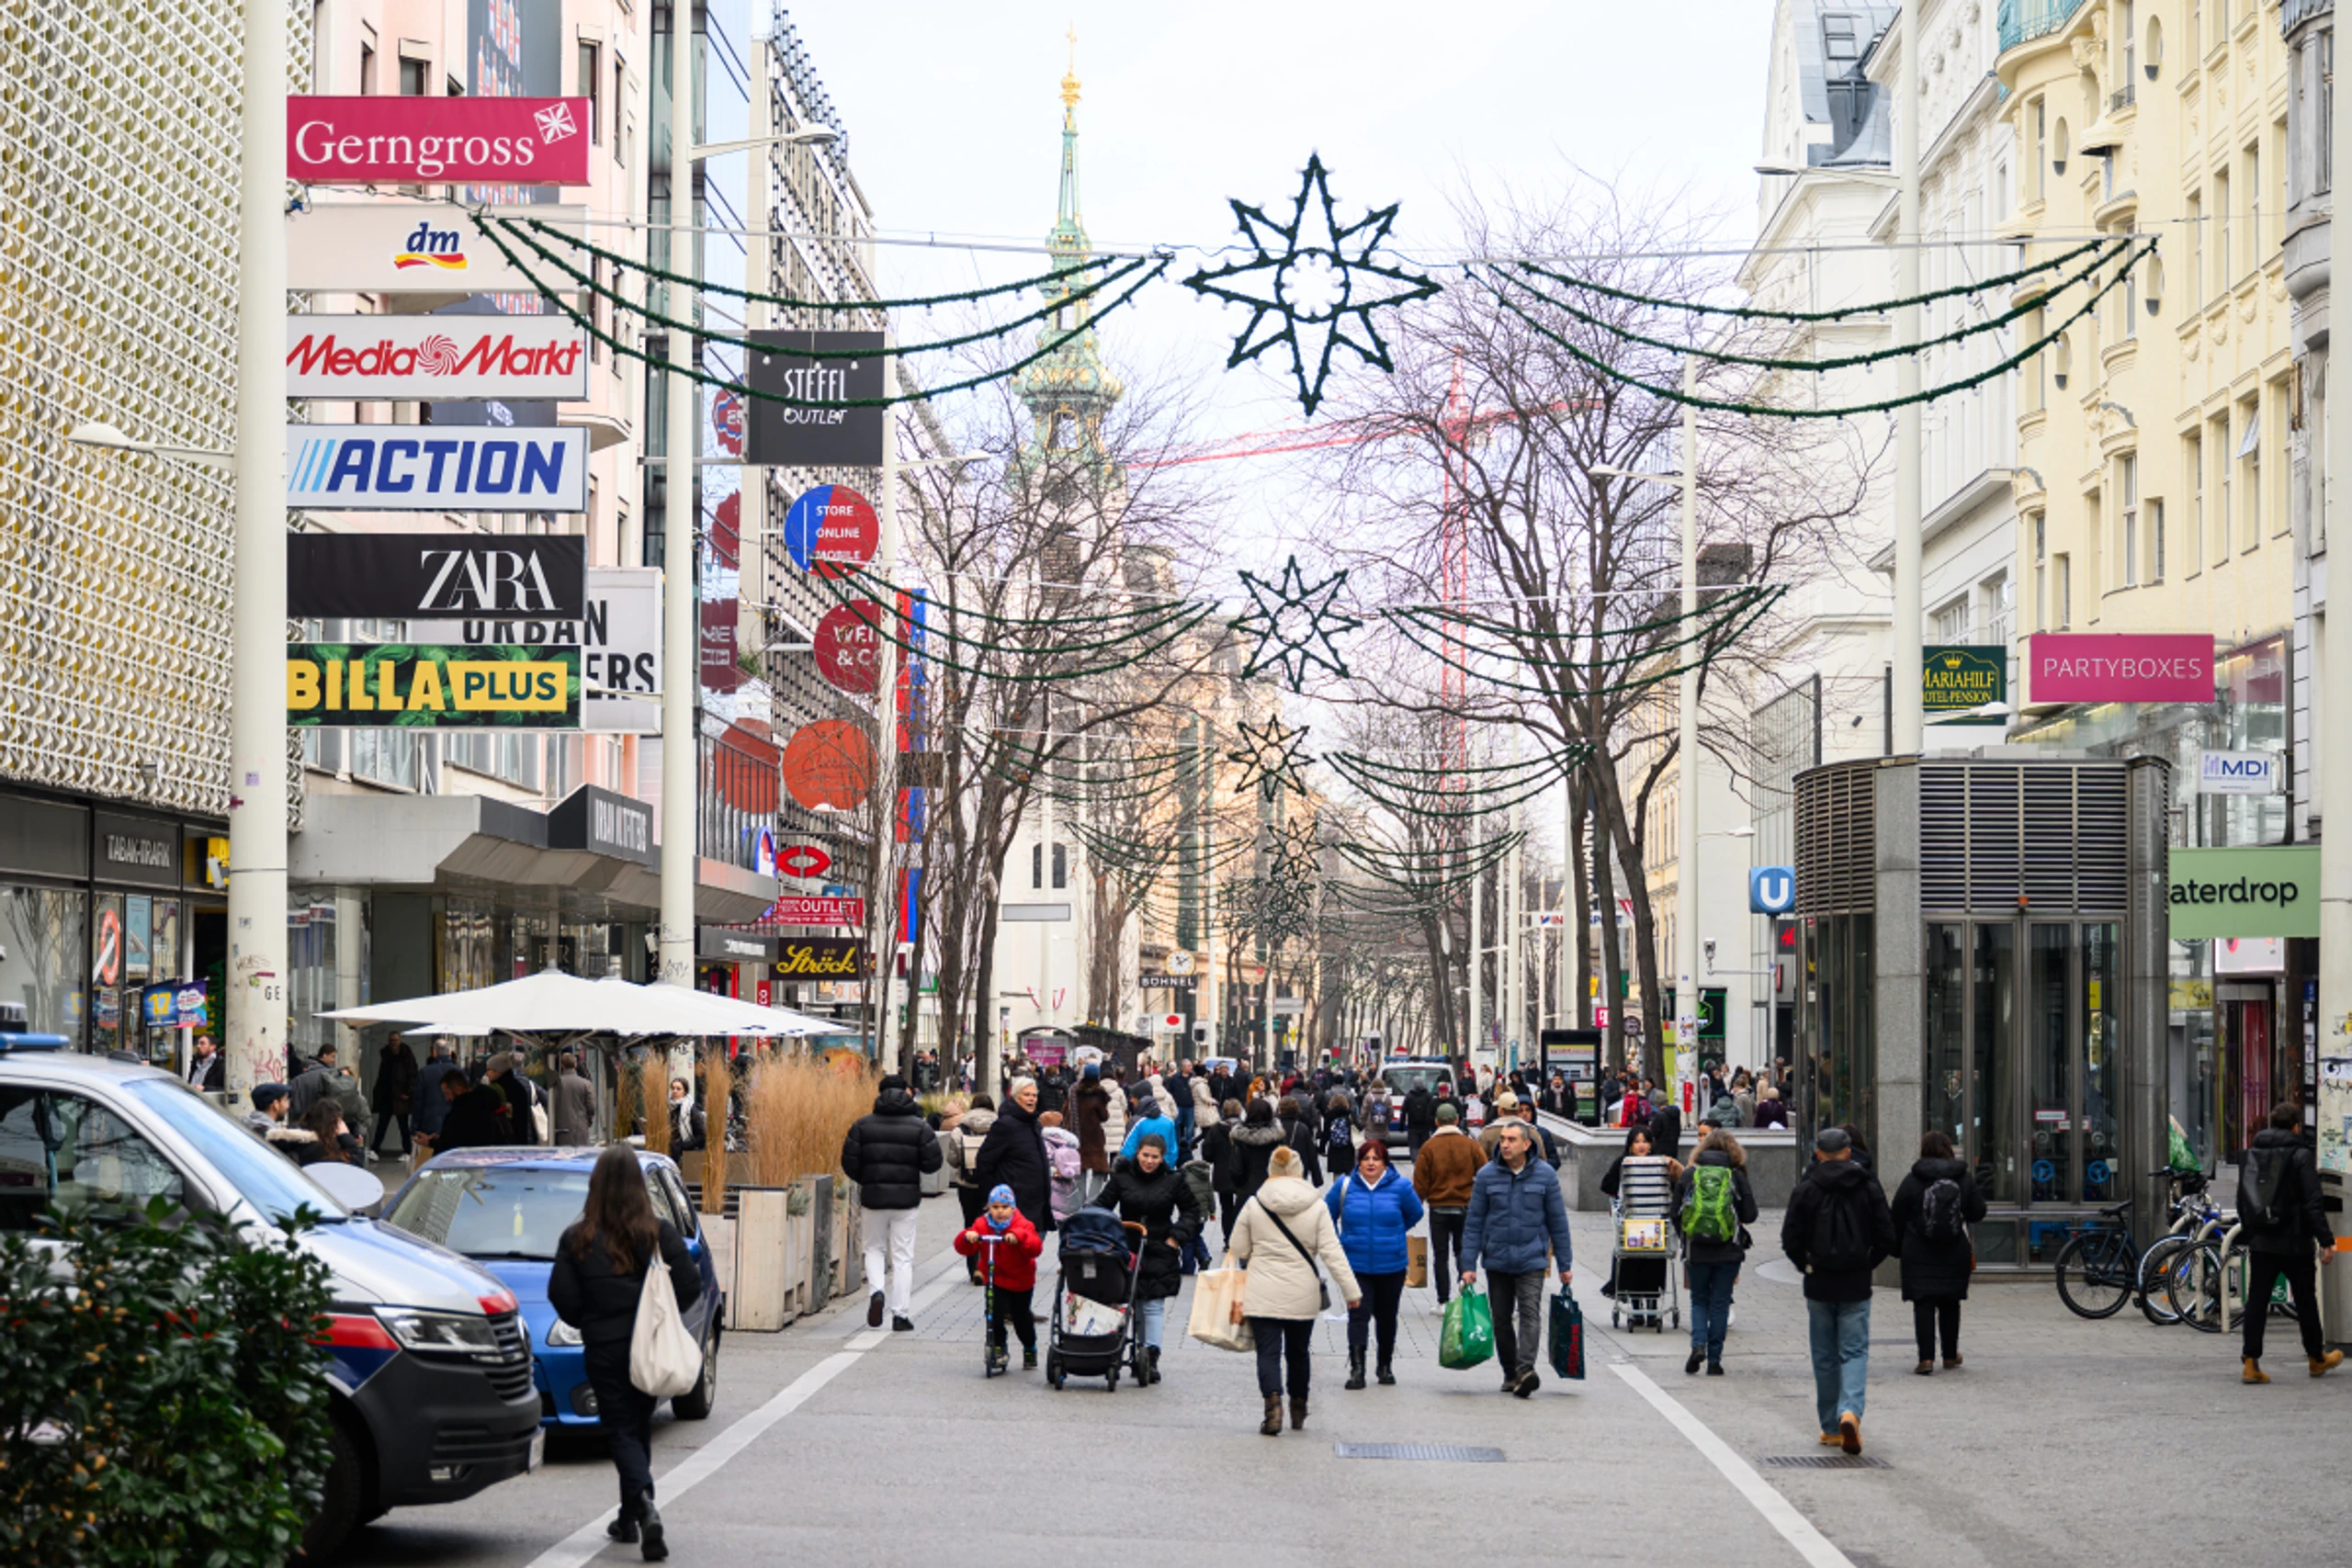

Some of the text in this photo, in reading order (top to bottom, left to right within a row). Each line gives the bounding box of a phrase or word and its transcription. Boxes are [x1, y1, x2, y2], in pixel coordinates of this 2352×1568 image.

[295, 120, 535, 176] Gerngross
[406, 222, 459, 253] dm
[287, 334, 582, 376] Media Markt
[784, 368, 848, 402] STEFFL
[784, 409, 848, 424] OUTLET
[326, 439, 566, 495] ACTION
[816, 506, 854, 516] STORE
[816, 527, 860, 538] ONLINE
[418, 548, 563, 612] ZARA
[837, 649, 854, 666] &
[2042, 658, 2202, 679] PARTYBOXES
[287, 660, 557, 710] BILLA PLUS
[2222, 760, 2268, 775] MDI
[800, 899, 856, 913] OUTLET
[1759, 877, 1790, 908] U
[2169, 877, 2299, 908] aterdrop
[776, 944, 856, 973] Ströck
[148, 992, 172, 1016] 17
